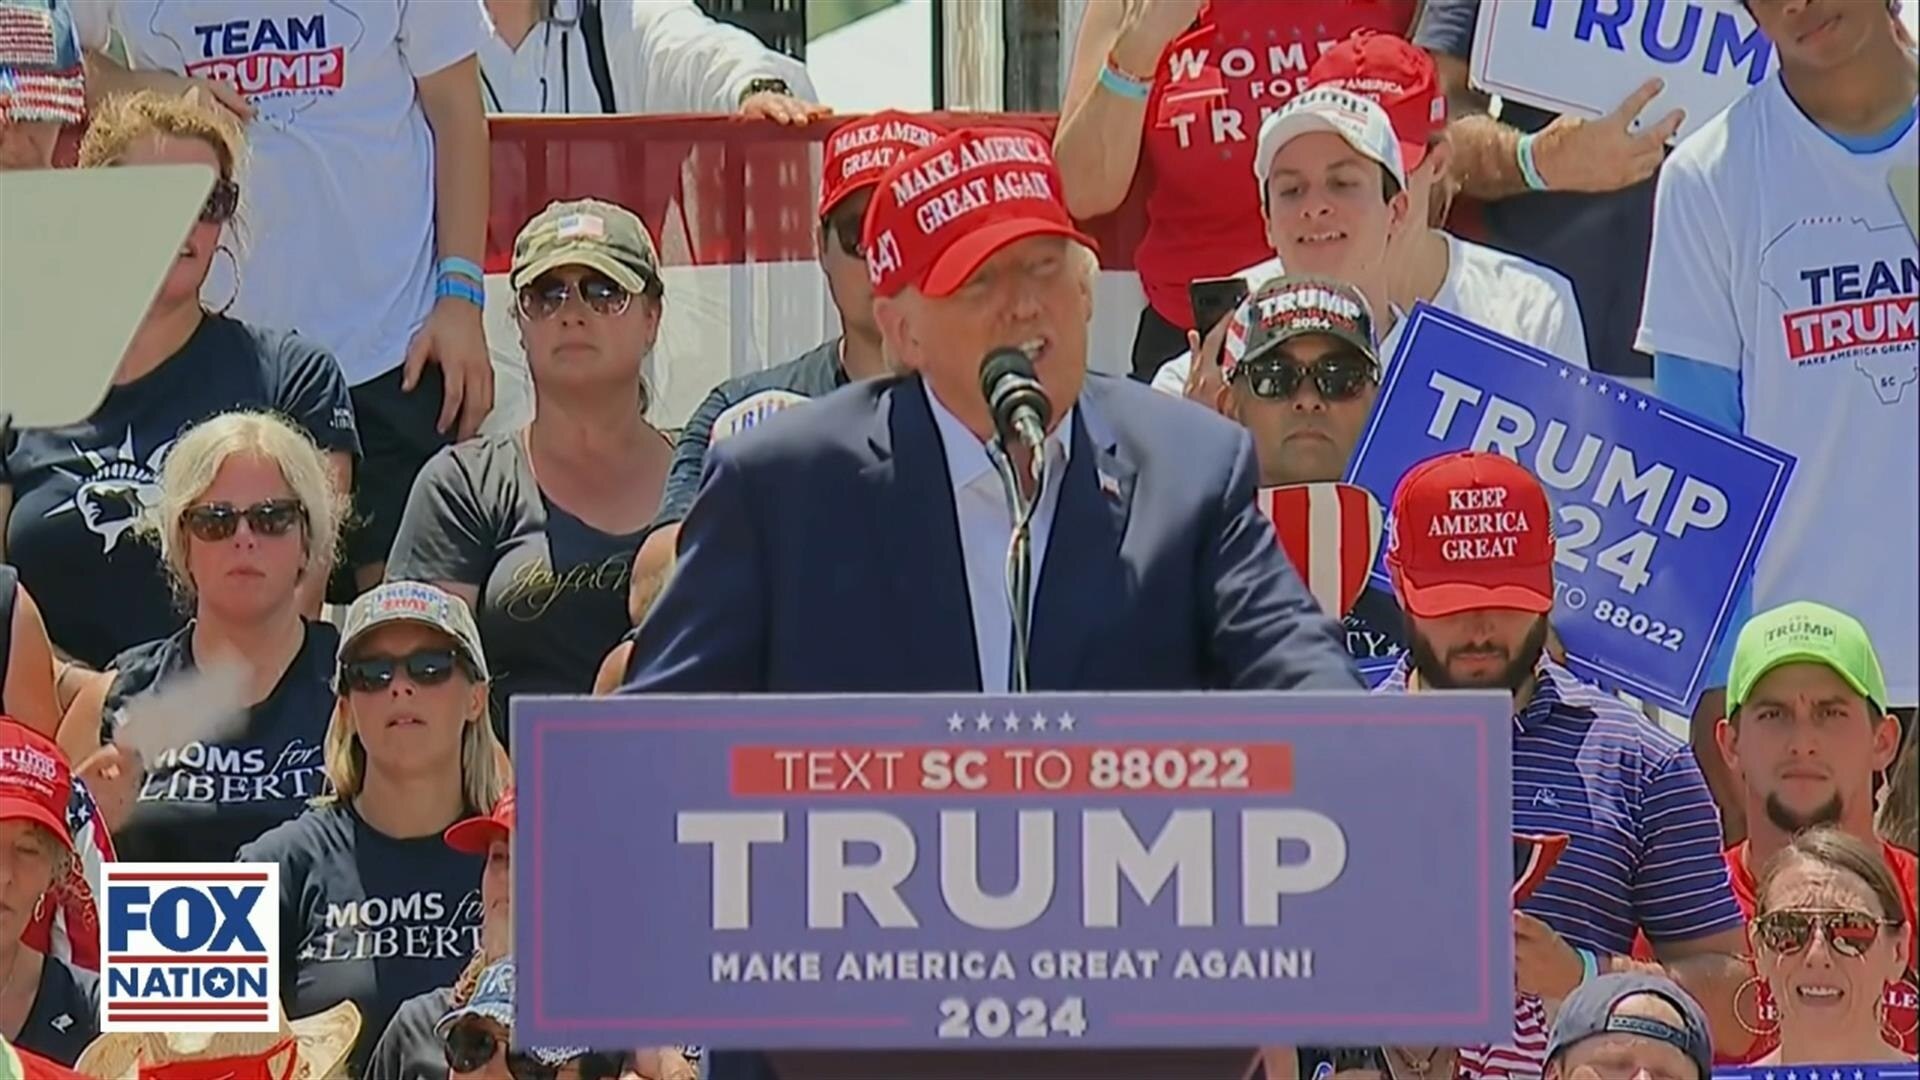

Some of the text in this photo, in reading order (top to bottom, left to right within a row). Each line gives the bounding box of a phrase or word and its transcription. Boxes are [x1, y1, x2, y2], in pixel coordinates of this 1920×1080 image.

[194, 14, 326, 58] TEAM
[834, 123, 880, 157] MAKE
[842, 147, 894, 179] GREAT
[891, 136, 1052, 208] MAKE AMERICA
[916, 171, 1052, 235] GREAT AGAIN
[1258, 289, 1361, 321] TRUMP
[1291, 317, 1332, 330] 2024
[1799, 341, 1917, 367] MAKE AMERICA GREAT
[1427, 370, 1730, 540] TRUMP
[1448, 486, 1508, 511] KEEP
[1427, 511, 1530, 537] AMERICA
[1441, 536, 1518, 562] GREAT
[1593, 599, 1684, 653] 88022
[1767, 621, 1834, 641] TRUMP
[268, 738, 321, 778] for
[774, 748, 1250, 791] TEXT SC TO 88022
[676, 809, 1348, 930] TRUMP
[325, 890, 446, 930] MOMS
[711, 948, 1315, 983] MAKE AMERICA GREAT AGAIN!
[937, 995, 1088, 1040] 2024
